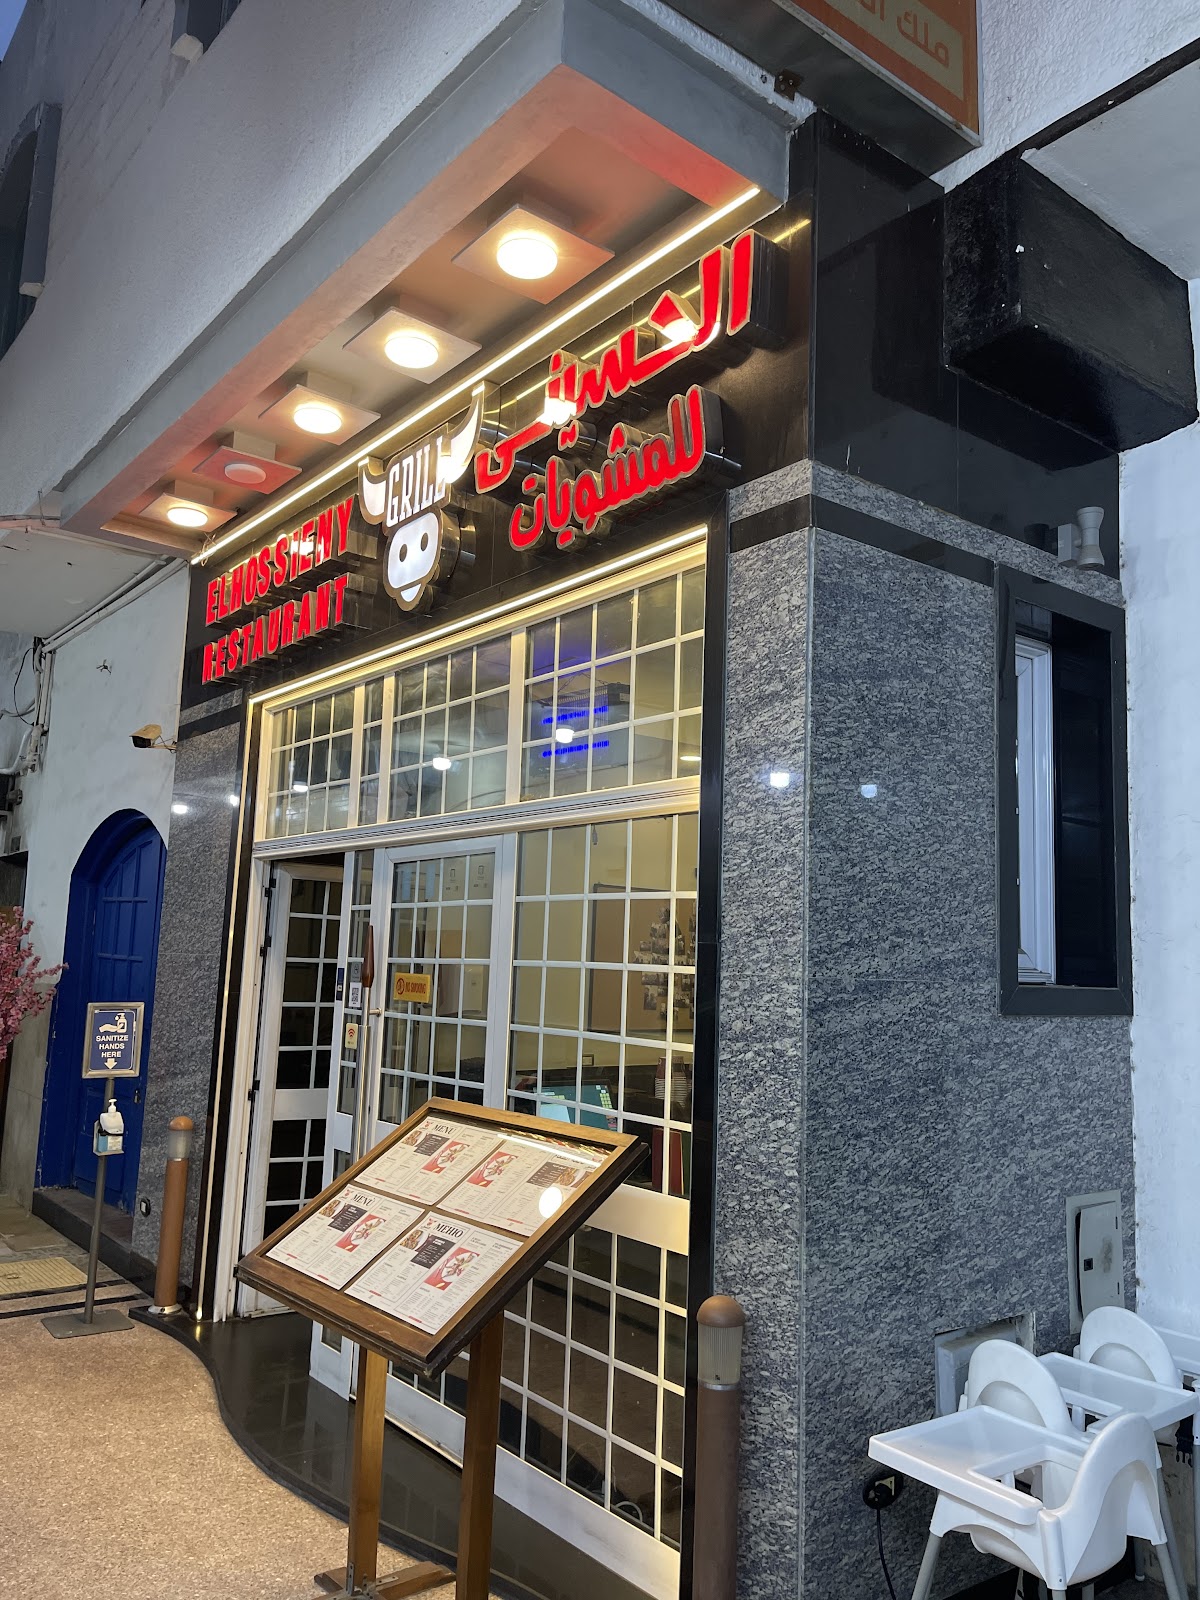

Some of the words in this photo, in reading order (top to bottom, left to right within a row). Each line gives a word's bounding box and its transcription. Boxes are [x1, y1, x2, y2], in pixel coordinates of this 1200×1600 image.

[896, 10, 949, 69] ملك
[386, 435, 447, 527] GRILL
[205, 496, 355, 626] ELHOSSIENY
[202, 573, 349, 685] RESTAURANT
[95, 1034, 129, 1042] SANITIZE
